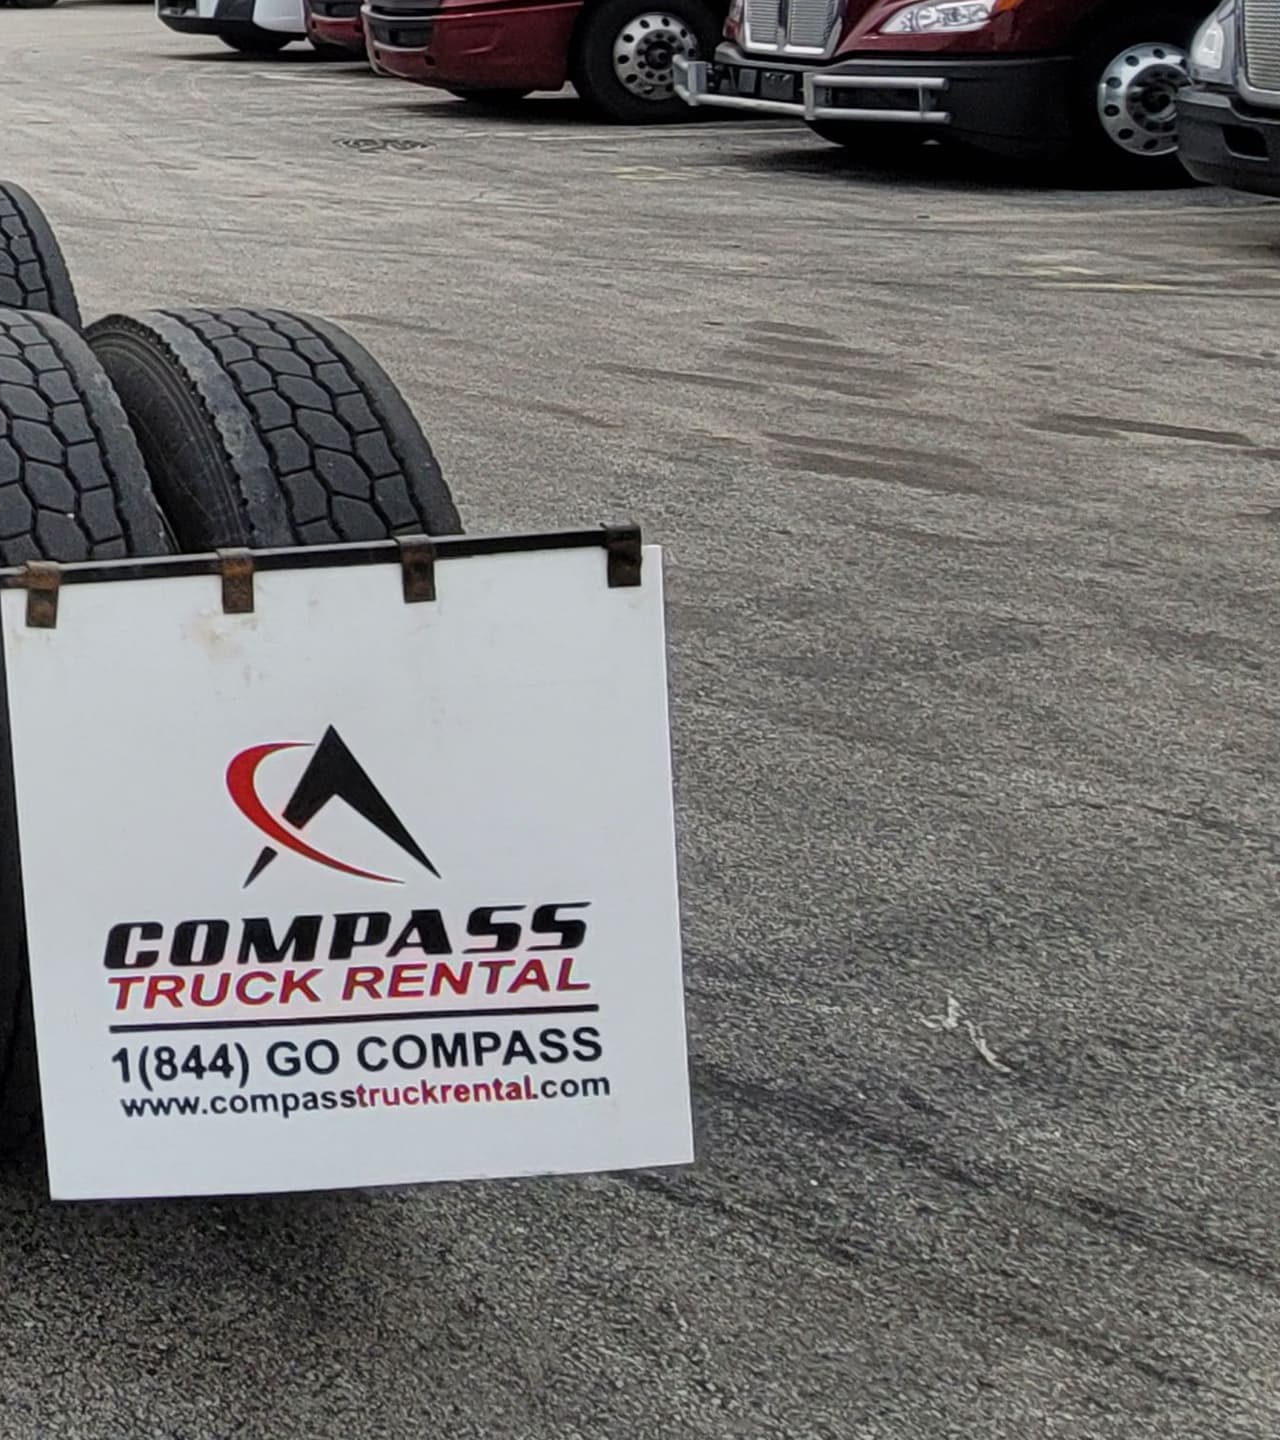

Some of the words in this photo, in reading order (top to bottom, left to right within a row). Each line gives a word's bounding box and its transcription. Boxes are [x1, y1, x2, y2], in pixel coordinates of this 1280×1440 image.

[103, 901, 592, 970] COMPASS
[108, 968, 323, 1011] TRUCK
[341, 957, 591, 1001] RENTAL
[111, 1042, 250, 1092] 1(844)
[265, 1038, 340, 1077] GO
[356, 1026, 603, 1073] COMPASS
[120, 1074, 611, 1119] www.compasstruckrental.com
